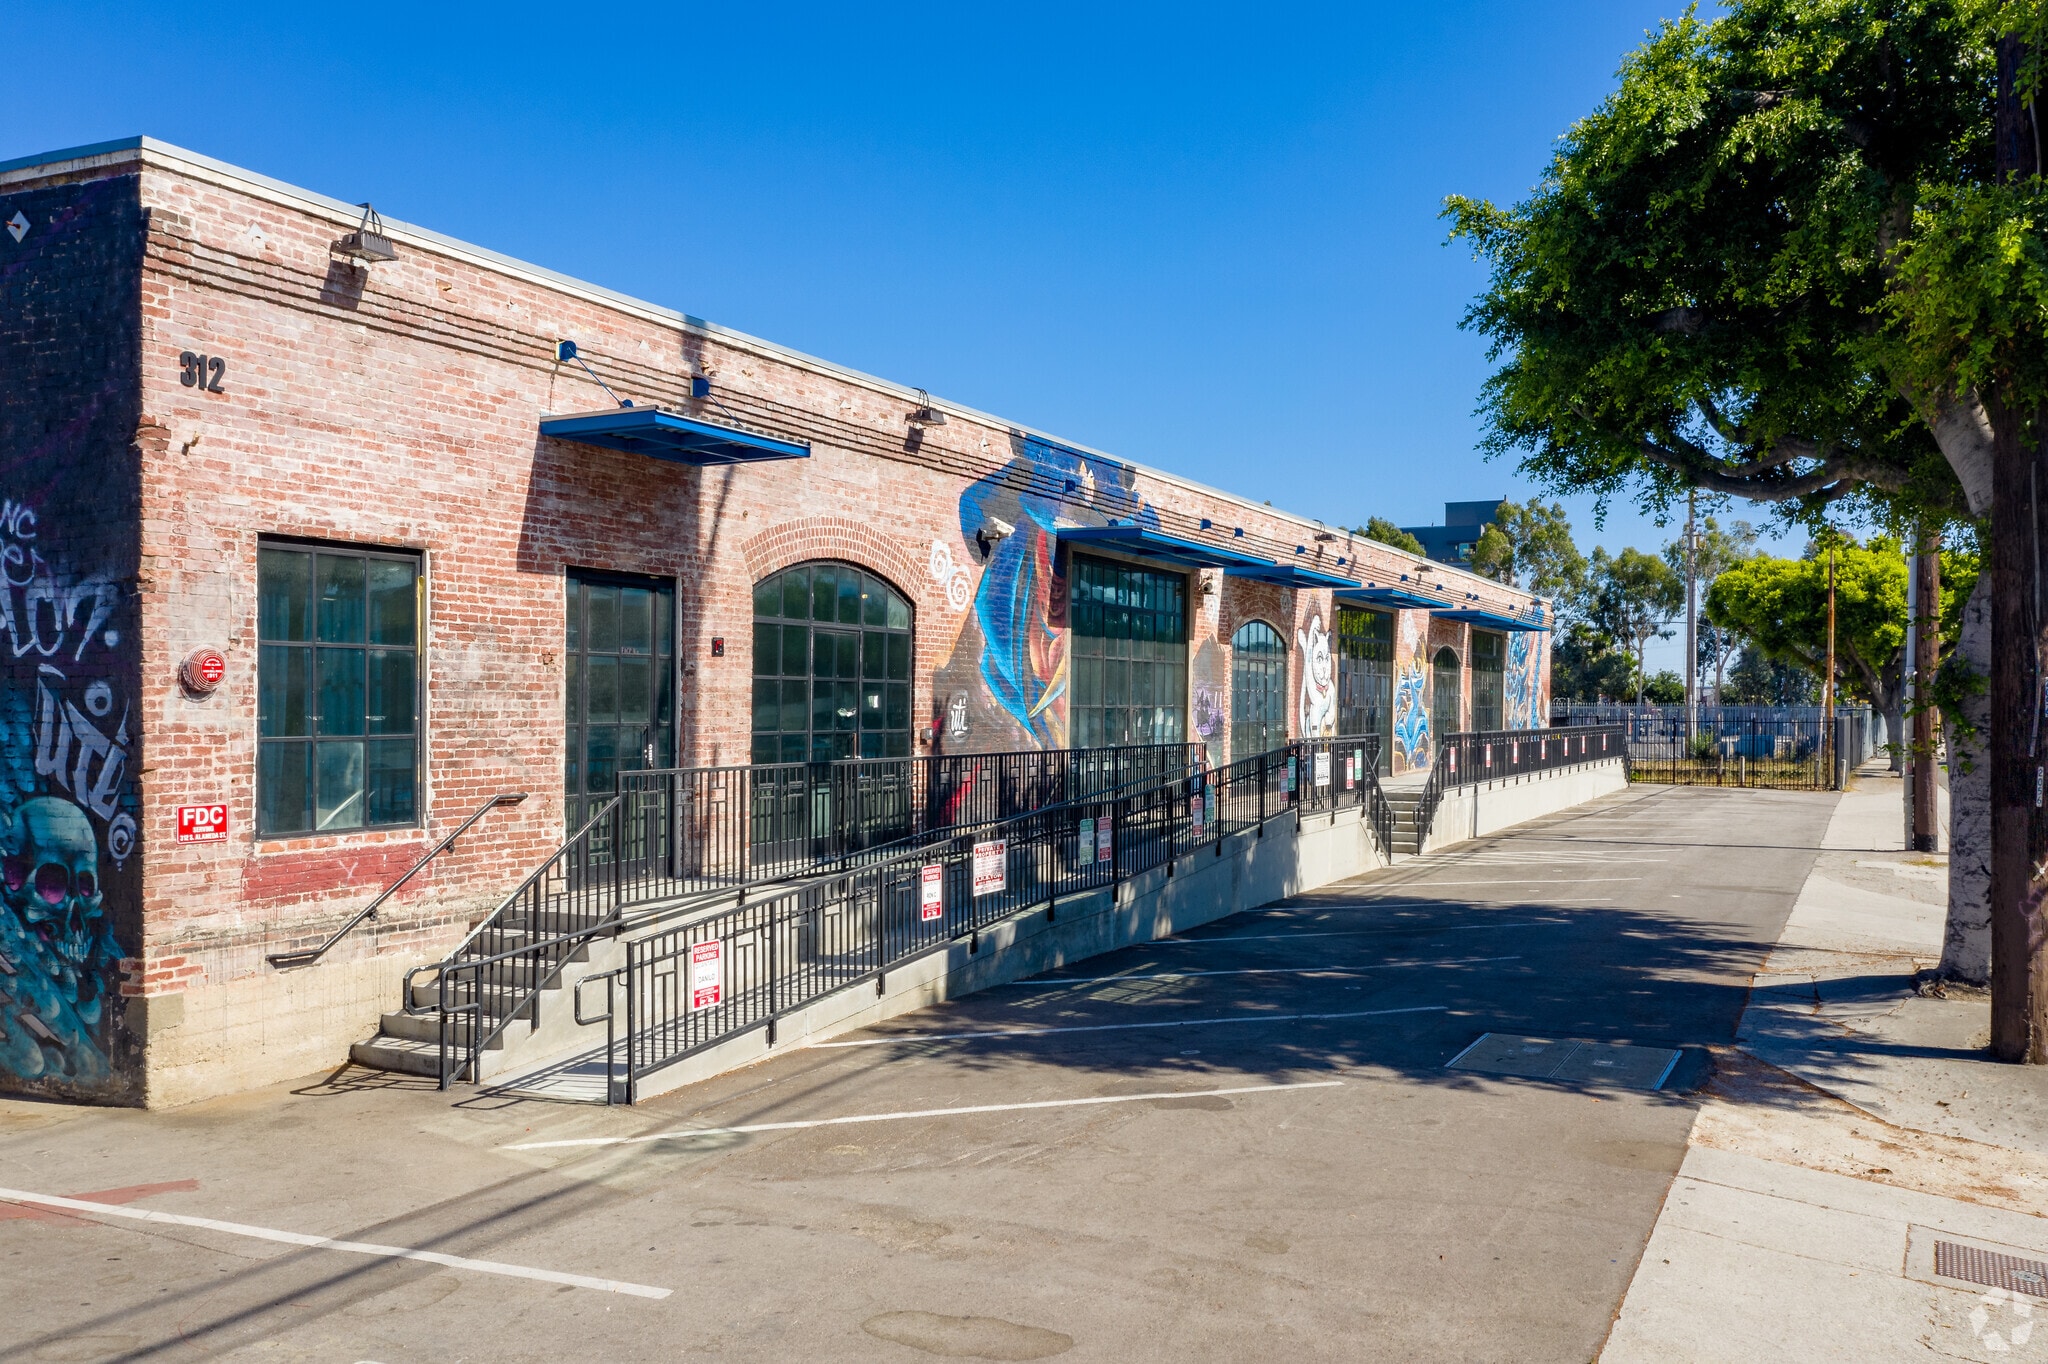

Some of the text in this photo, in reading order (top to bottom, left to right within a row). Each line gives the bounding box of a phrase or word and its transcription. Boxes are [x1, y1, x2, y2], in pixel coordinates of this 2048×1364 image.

[180, 351, 226, 394] 312
[183, 806, 224, 826] FDC
[976, 849, 1004, 858] PROPERTY
[978, 844, 1001, 853] PRIVATE
[694, 943, 719, 954] RESERVED
[695, 951, 717, 962] PARKING
